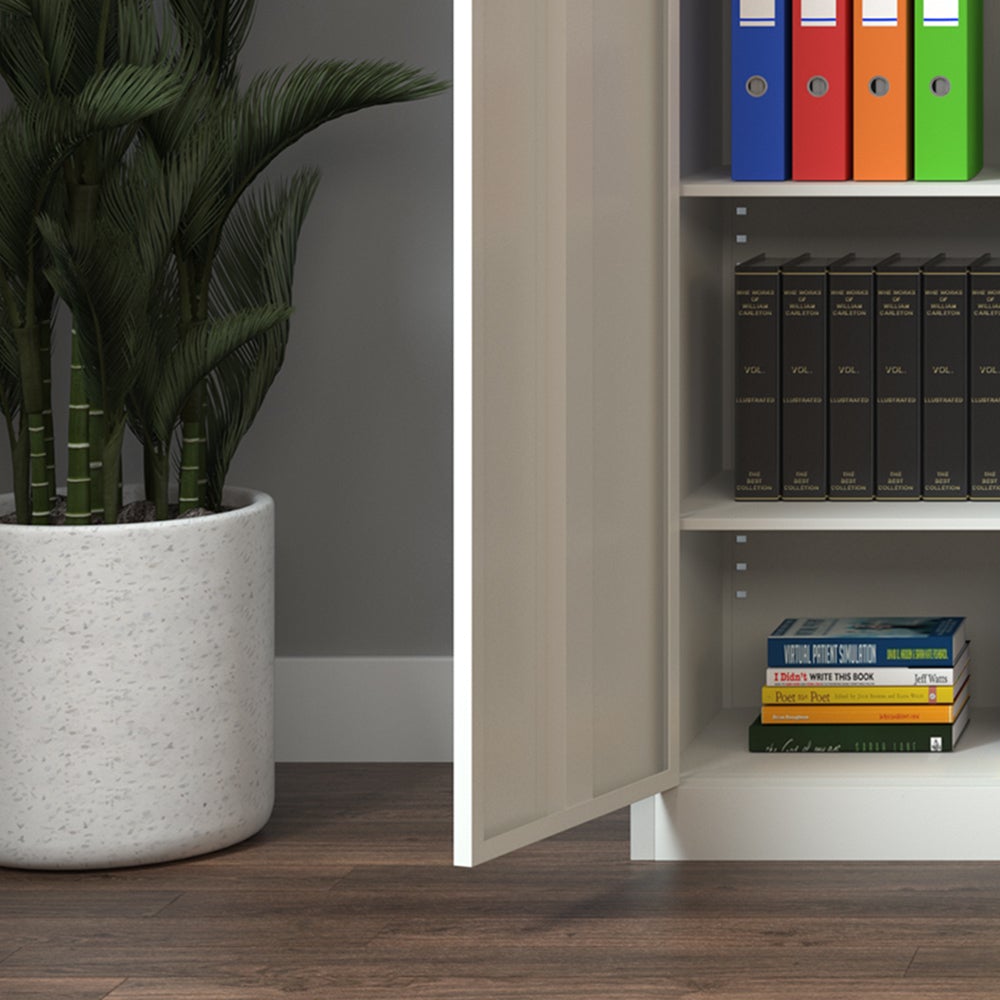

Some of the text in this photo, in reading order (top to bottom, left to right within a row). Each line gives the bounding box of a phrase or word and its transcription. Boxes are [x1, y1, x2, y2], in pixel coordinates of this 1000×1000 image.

[784, 644, 810, 664] VIRTUAL
[812, 644, 837, 664] PATIENT
[774, 672, 874, 681] I Didn't WRITE THIS BOOK
[914, 673, 927, 684] Jeff
[775, 691, 831, 702] Poet Poet
